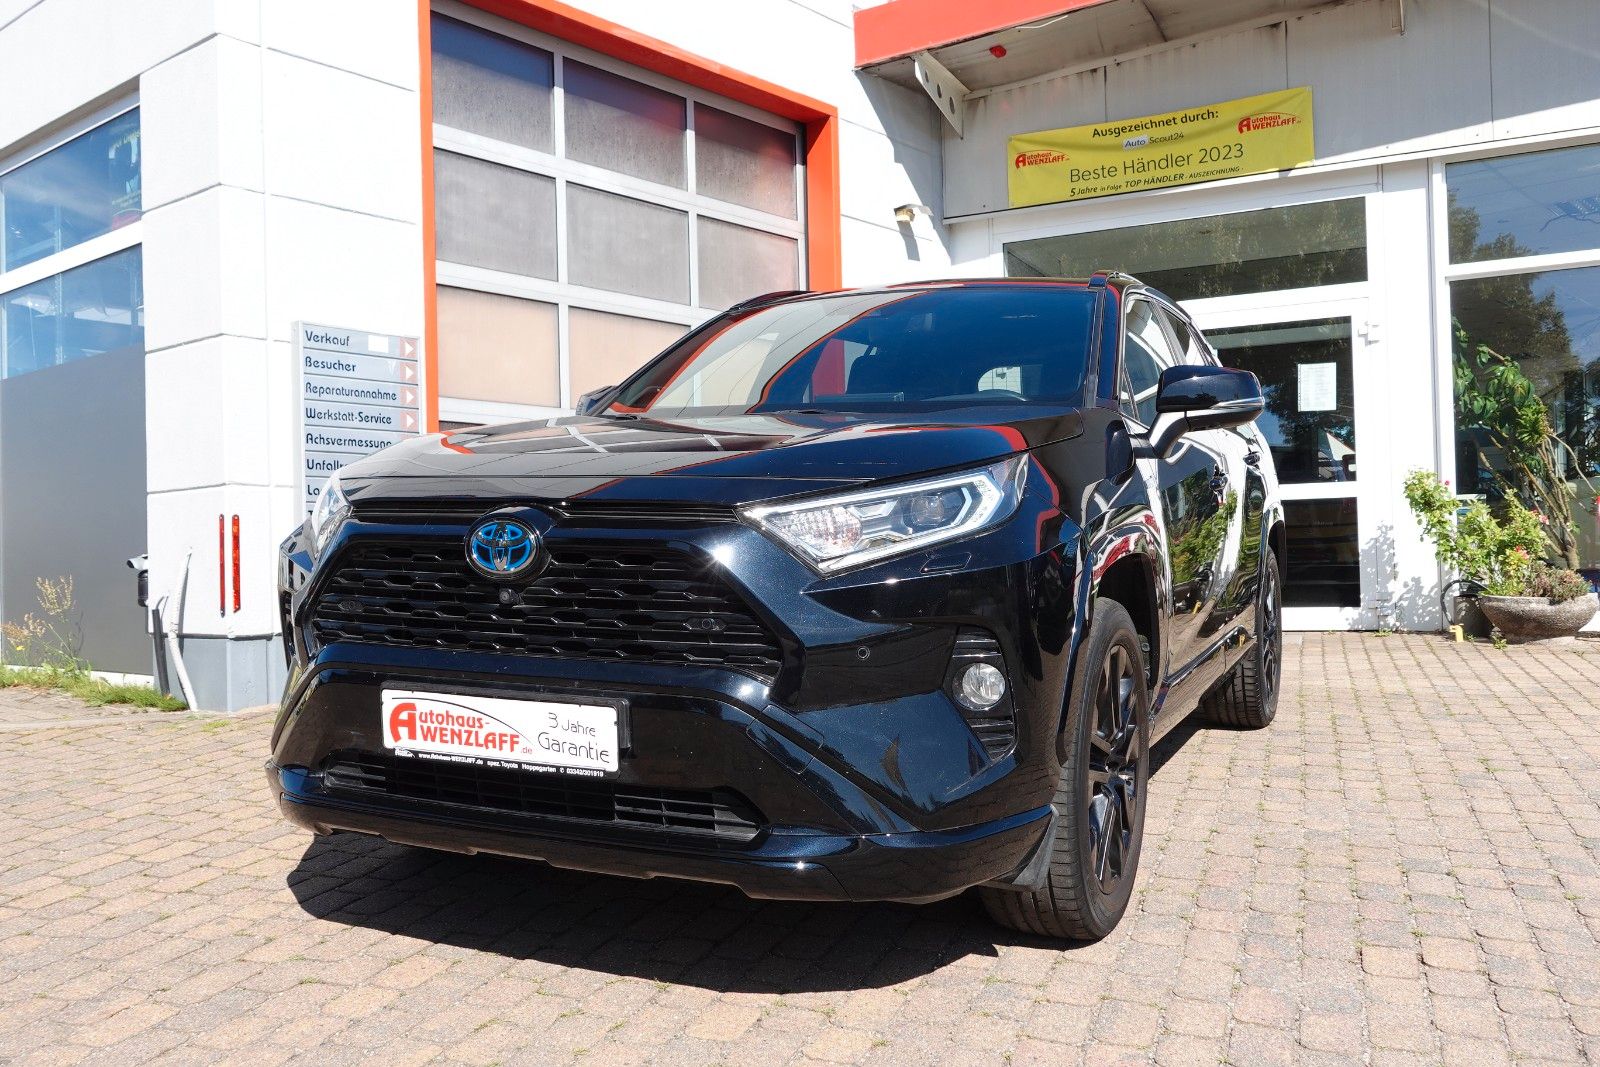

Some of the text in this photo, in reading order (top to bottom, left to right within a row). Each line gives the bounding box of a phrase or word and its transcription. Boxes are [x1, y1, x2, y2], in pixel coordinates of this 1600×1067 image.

[1092, 109, 1220, 138] Ausgezeichnet durch:
[1238, 114, 1281, 134] Autohaus
[1252, 117, 1297, 131] WENZLAFF
[1124, 131, 1185, 149] Auto Scout24
[1027, 155, 1066, 166] WENZLAFF
[1070, 143, 1244, 183] Beste Händler 2023
[1070, 187, 1076, 197] 5
[1077, 186, 1098, 195] Jahre
[1125, 180, 1142, 188] TOP
[1144, 173, 1185, 186] HÄNDLER
[1189, 166, 1240, 179] AUSZEICHNUNG
[305, 330, 350, 347] Verkauf
[305, 356, 357, 372] Besucher
[305, 382, 397, 401] Reparaturannahme
[305, 407, 392, 424] Werkstatt-Service
[548, 712, 596, 738] 3 Jahre
[419, 725, 520, 752] WENZLAFF
[537, 732, 610, 764] Garantie
